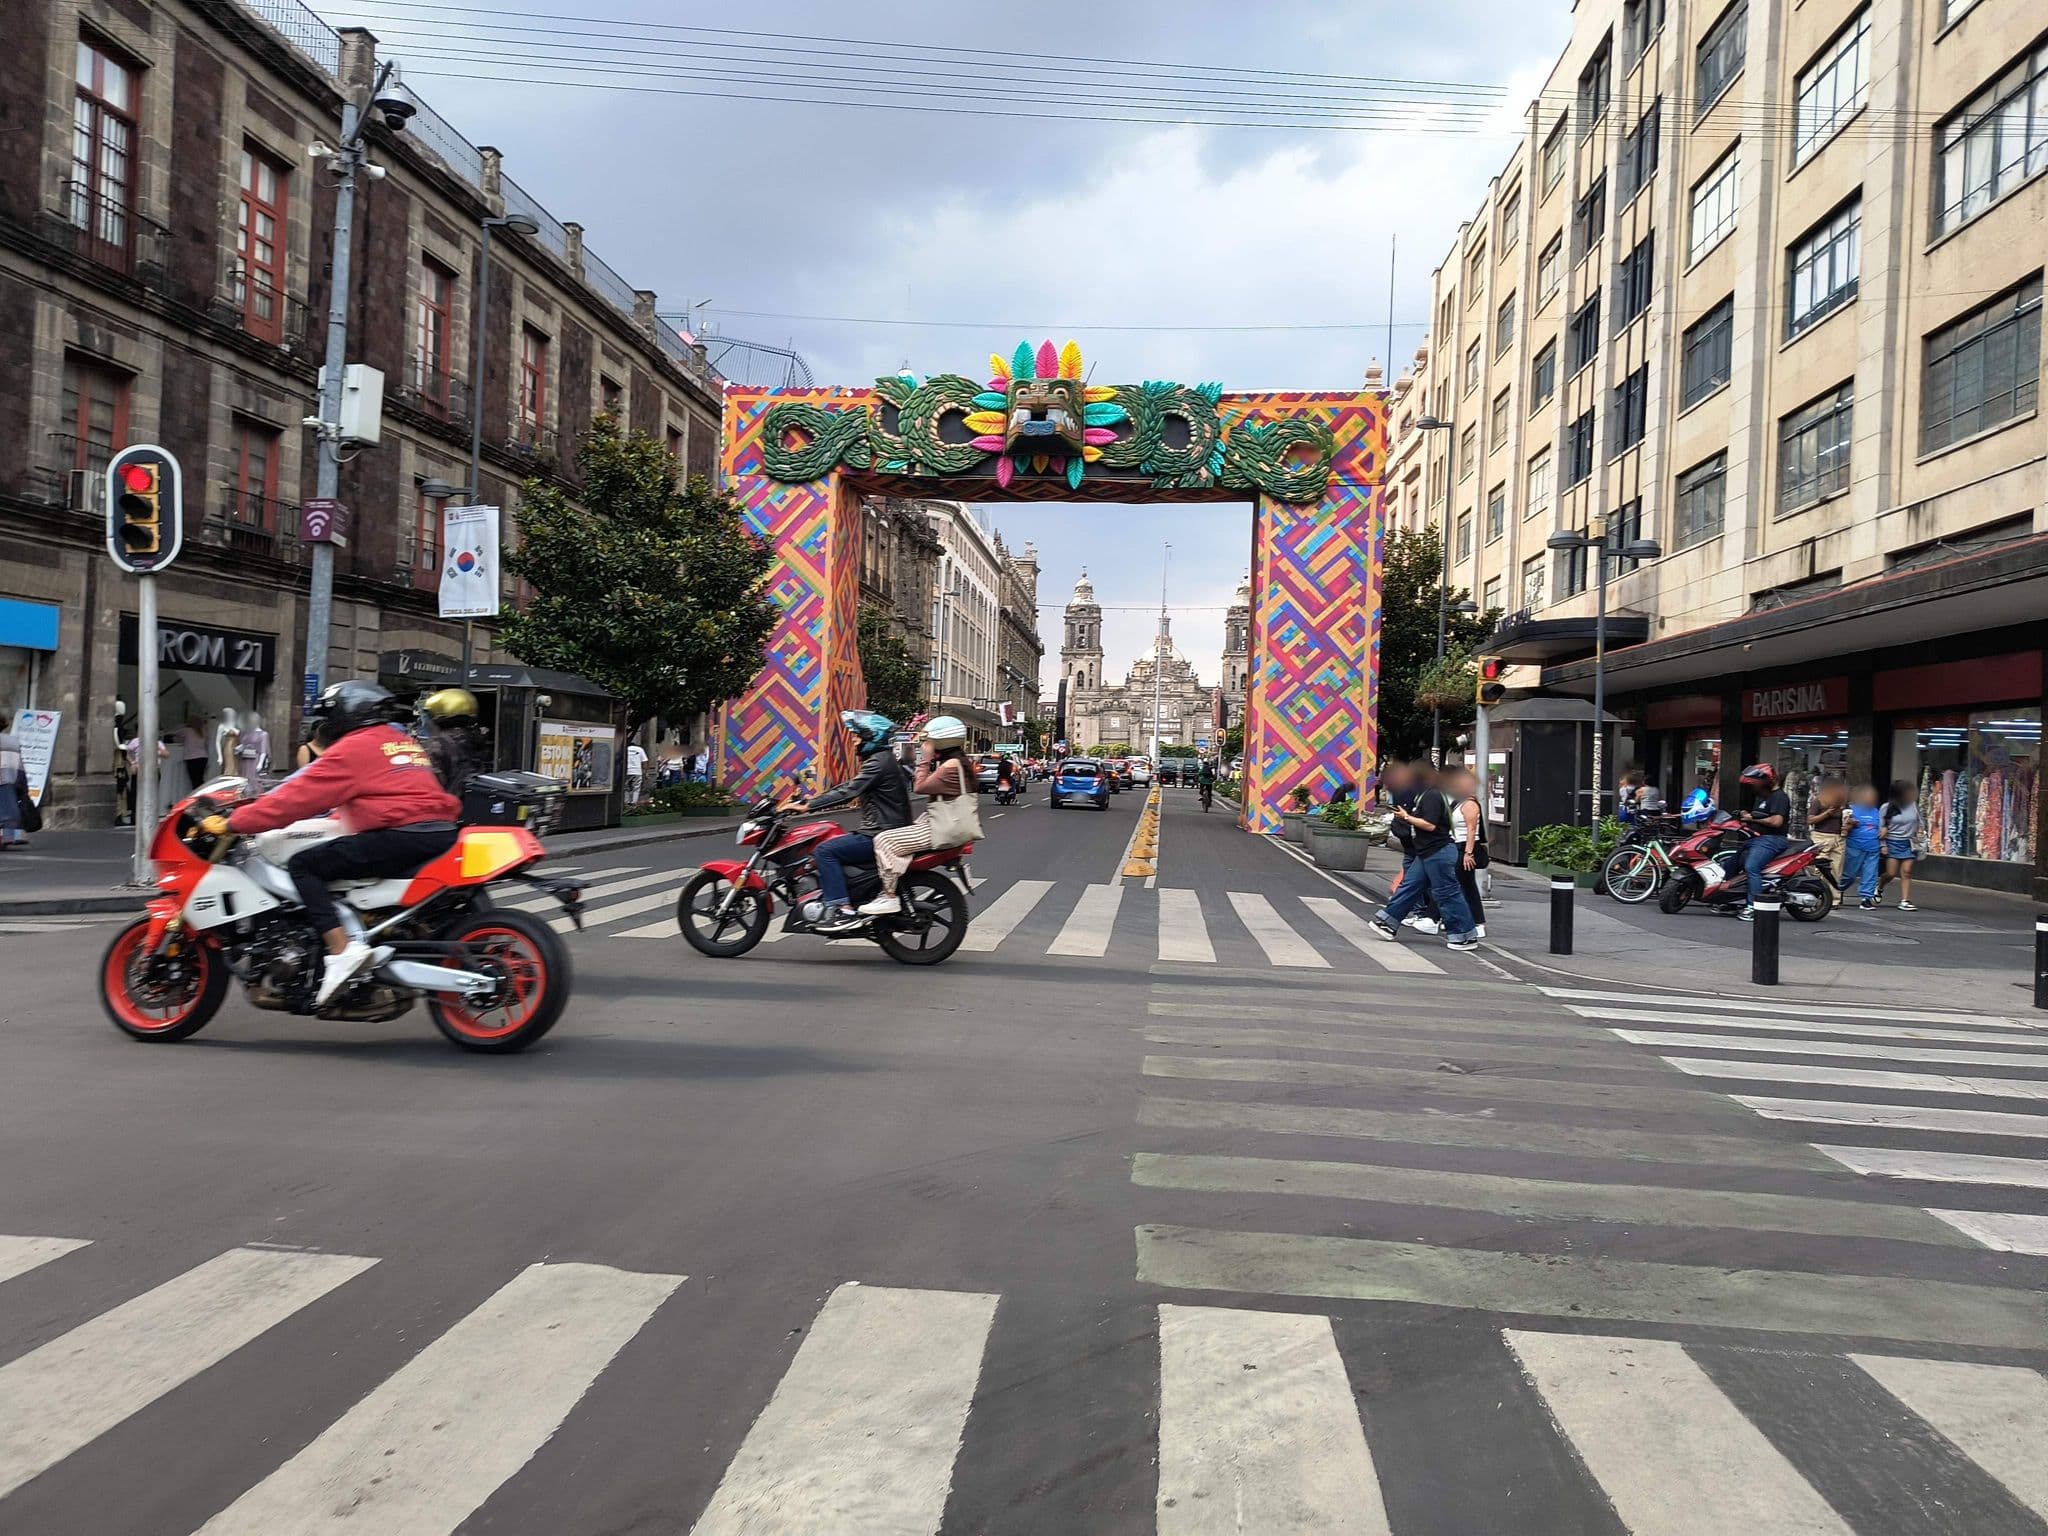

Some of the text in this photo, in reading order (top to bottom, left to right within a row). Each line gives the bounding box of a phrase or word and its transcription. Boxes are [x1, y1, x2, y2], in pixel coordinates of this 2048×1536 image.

[157, 629, 263, 672] ROM 21
[1752, 684, 1826, 717] PARISINA
